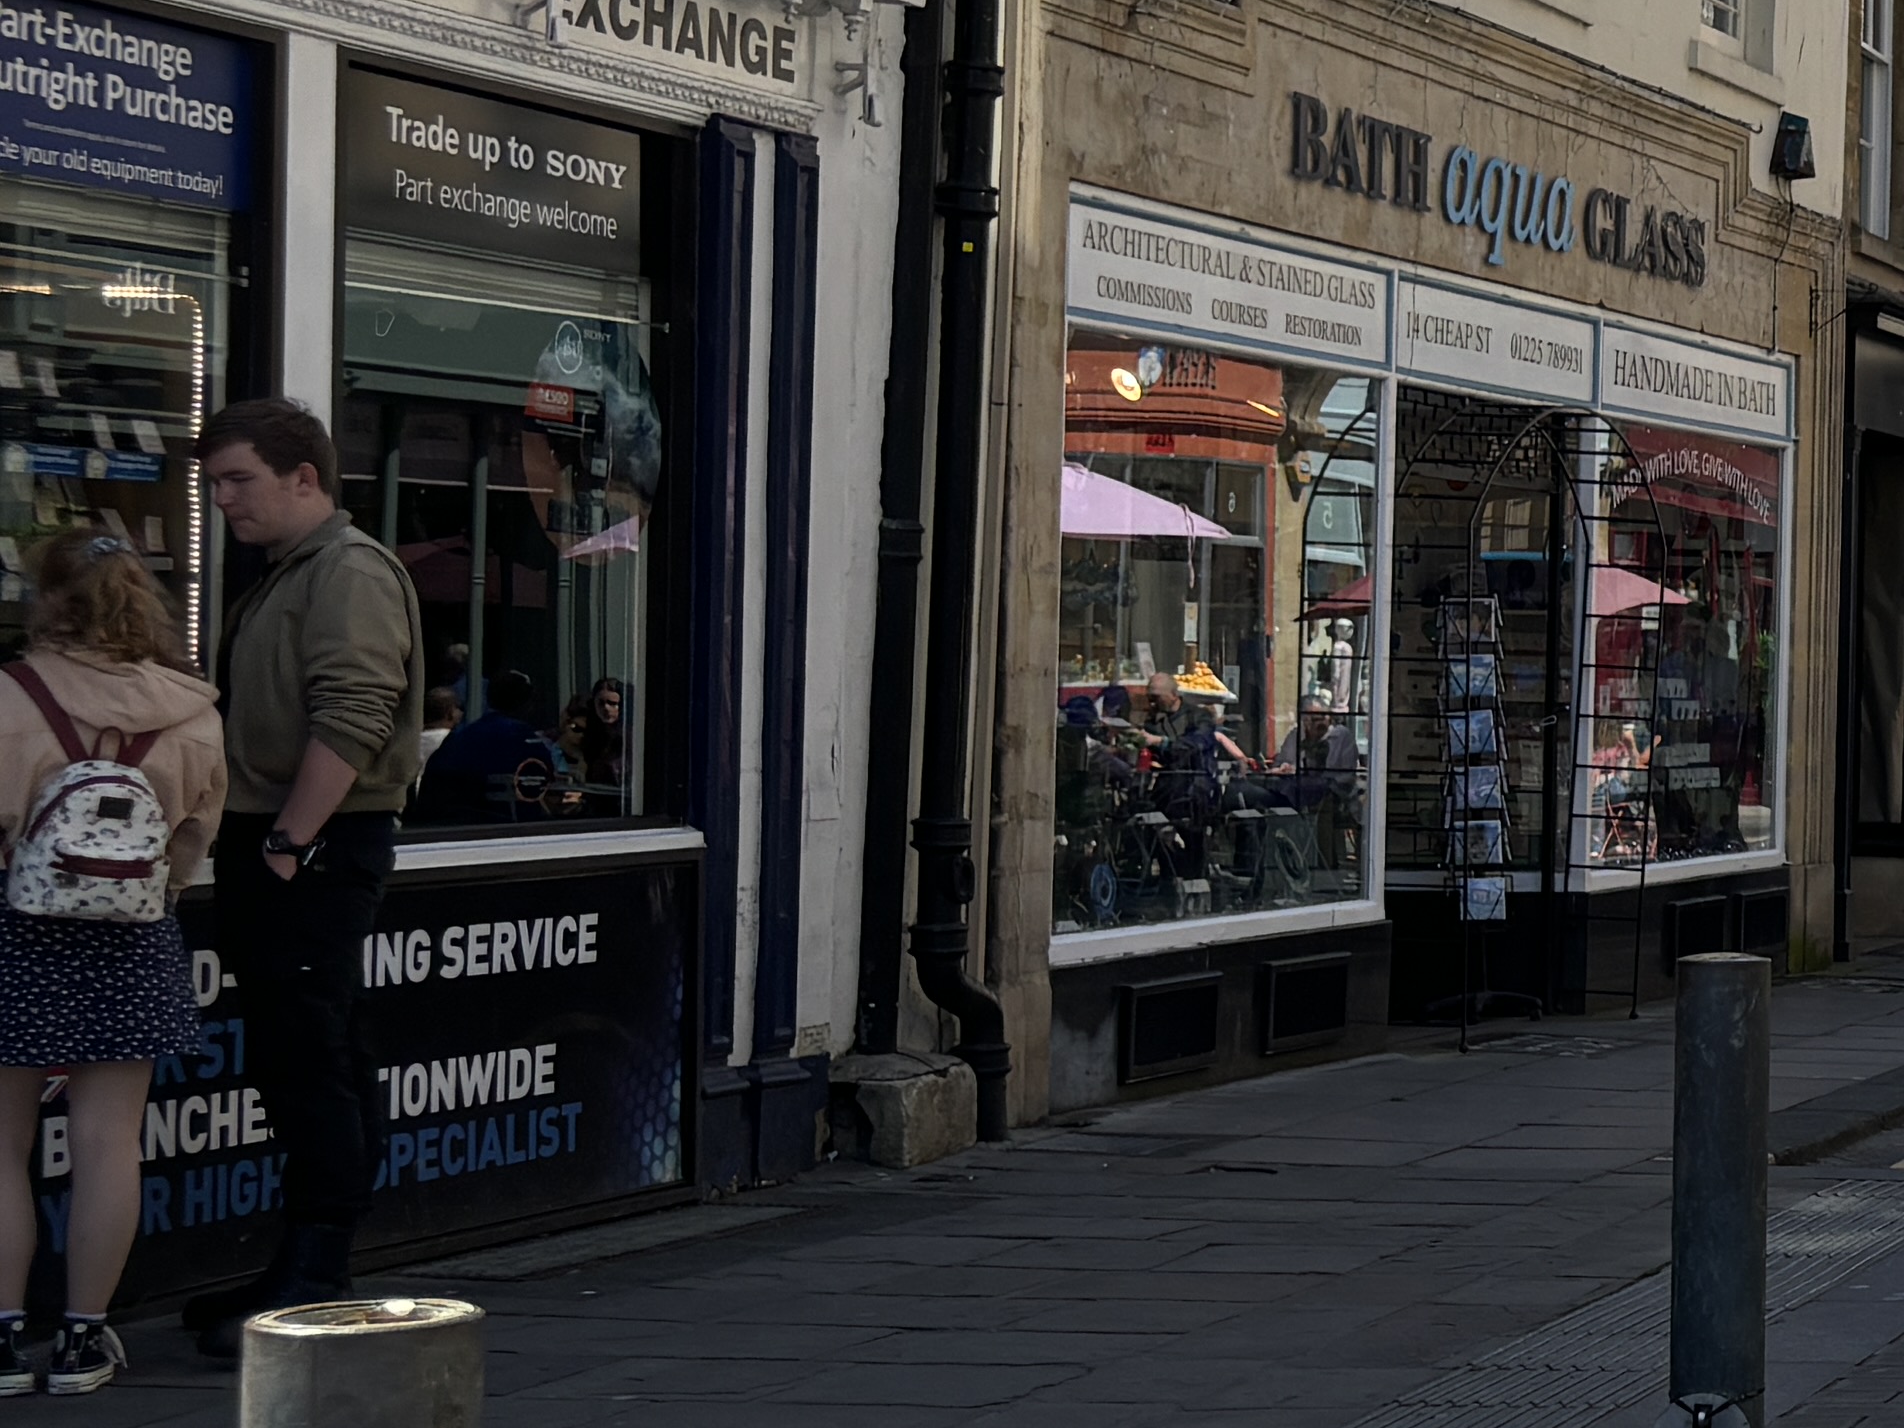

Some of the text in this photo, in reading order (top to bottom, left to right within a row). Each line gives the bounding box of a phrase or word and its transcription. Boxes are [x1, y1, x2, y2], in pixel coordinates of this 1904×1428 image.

[0, 2, 193, 81] art-Exchange
[0, 56, 234, 134] utright Purchase
[21, 148, 59, 167] your
[62, 148, 88, 172] old
[91, 158, 174, 194] equipment
[177, 172, 224, 198] today!
[386, 105, 627, 189] Trade up to SONY
[395, 169, 618, 239] Part exchange welcome
[1293, 91, 1708, 286] BATH aqua GLASS
[1082, 221, 1376, 309] ARCHITECTURAL & STAINED GLASS
[1097, 275, 1363, 347] COMMISSIONS COURSES RESTORATION
[1424, 314, 1473, 348] CHEAP
[1474, 327, 1493, 354] ST
[1510, 333, 1543, 364] 01225
[1547, 342, 1583, 375] 789931
[1613, 349, 1776, 417] HANDMADE IN BATH
[1613, 467, 1643, 509] MAD
[1645, 448, 1674, 483] WITH
[1702, 452, 1724, 482] GIVE
[1724, 460, 1748, 497] WITH
[1748, 481, 1772, 525] LOVE
[440, 912, 599, 977] SERVICE
